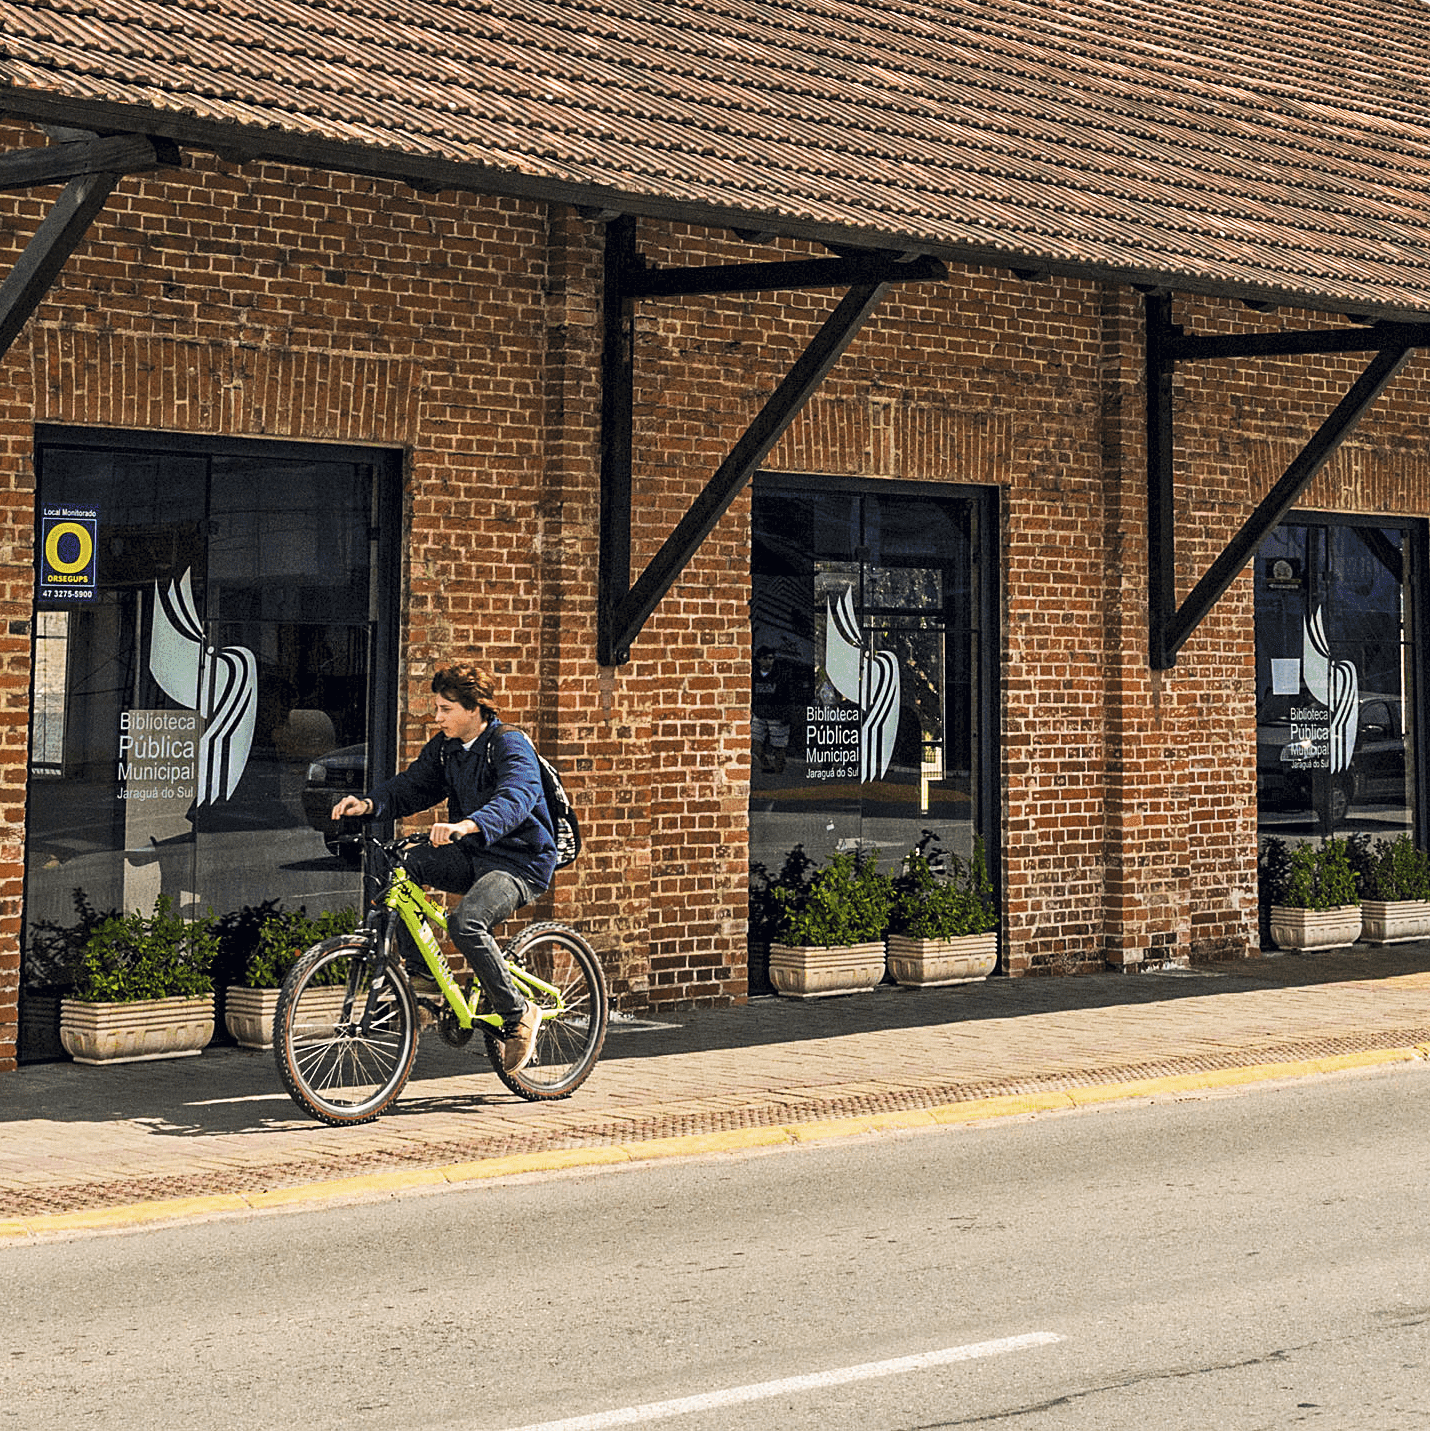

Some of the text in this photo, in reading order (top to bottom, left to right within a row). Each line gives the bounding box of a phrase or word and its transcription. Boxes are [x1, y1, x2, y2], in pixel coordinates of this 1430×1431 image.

[43, 508, 97, 517] Local Monitorado
[47, 574, 89, 583] ORSEGUPS
[42, 590, 93, 598] 47 3275-5900
[120, 712, 196, 730] Biblioteca
[806, 706, 859, 721] Biblioteca
[1291, 707, 1328, 720] Biblioteca
[806, 725, 859, 745] Pública
[1291, 723, 1328, 740] Pública
[119, 734, 195, 759] Pública
[806, 746, 859, 766] Municipal
[118, 761, 195, 784] Municipal
[806, 766, 859, 780] Jaraguá do Sul
[117, 785, 194, 802] Jaraguá do Sul
